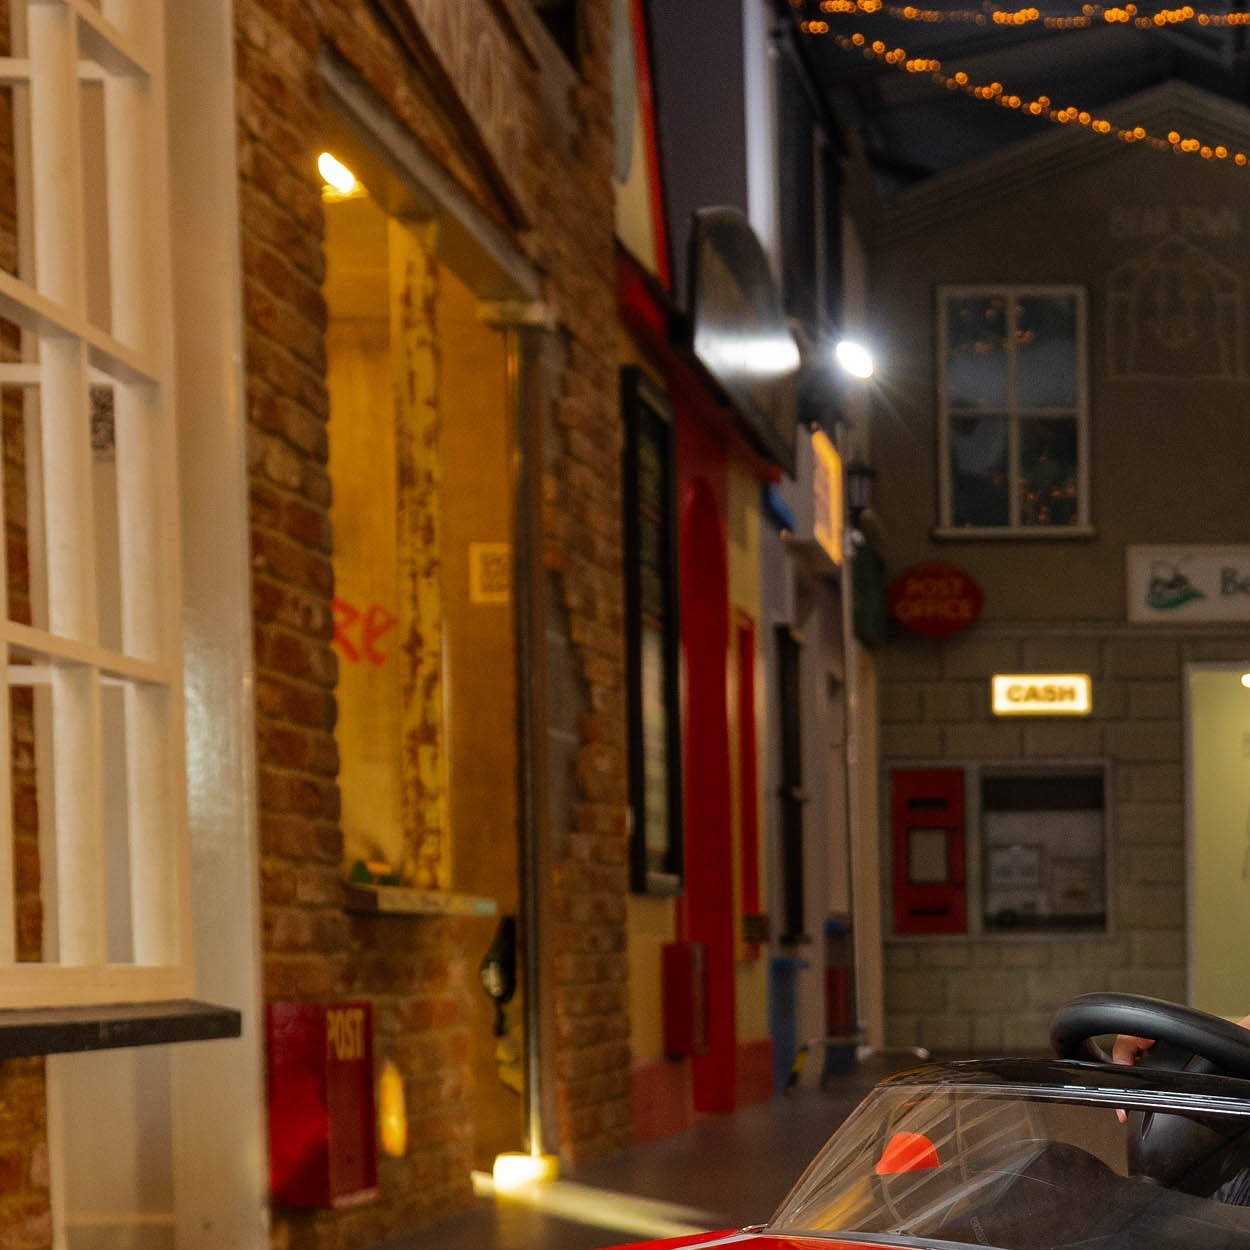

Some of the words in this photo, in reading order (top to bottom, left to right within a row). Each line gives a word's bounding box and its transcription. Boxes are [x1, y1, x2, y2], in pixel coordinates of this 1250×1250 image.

[905, 577, 962, 598] POST
[895, 599, 972, 619] OFFICE
[1006, 684, 1076, 702] CASH
[327, 1009, 365, 1060] POST
